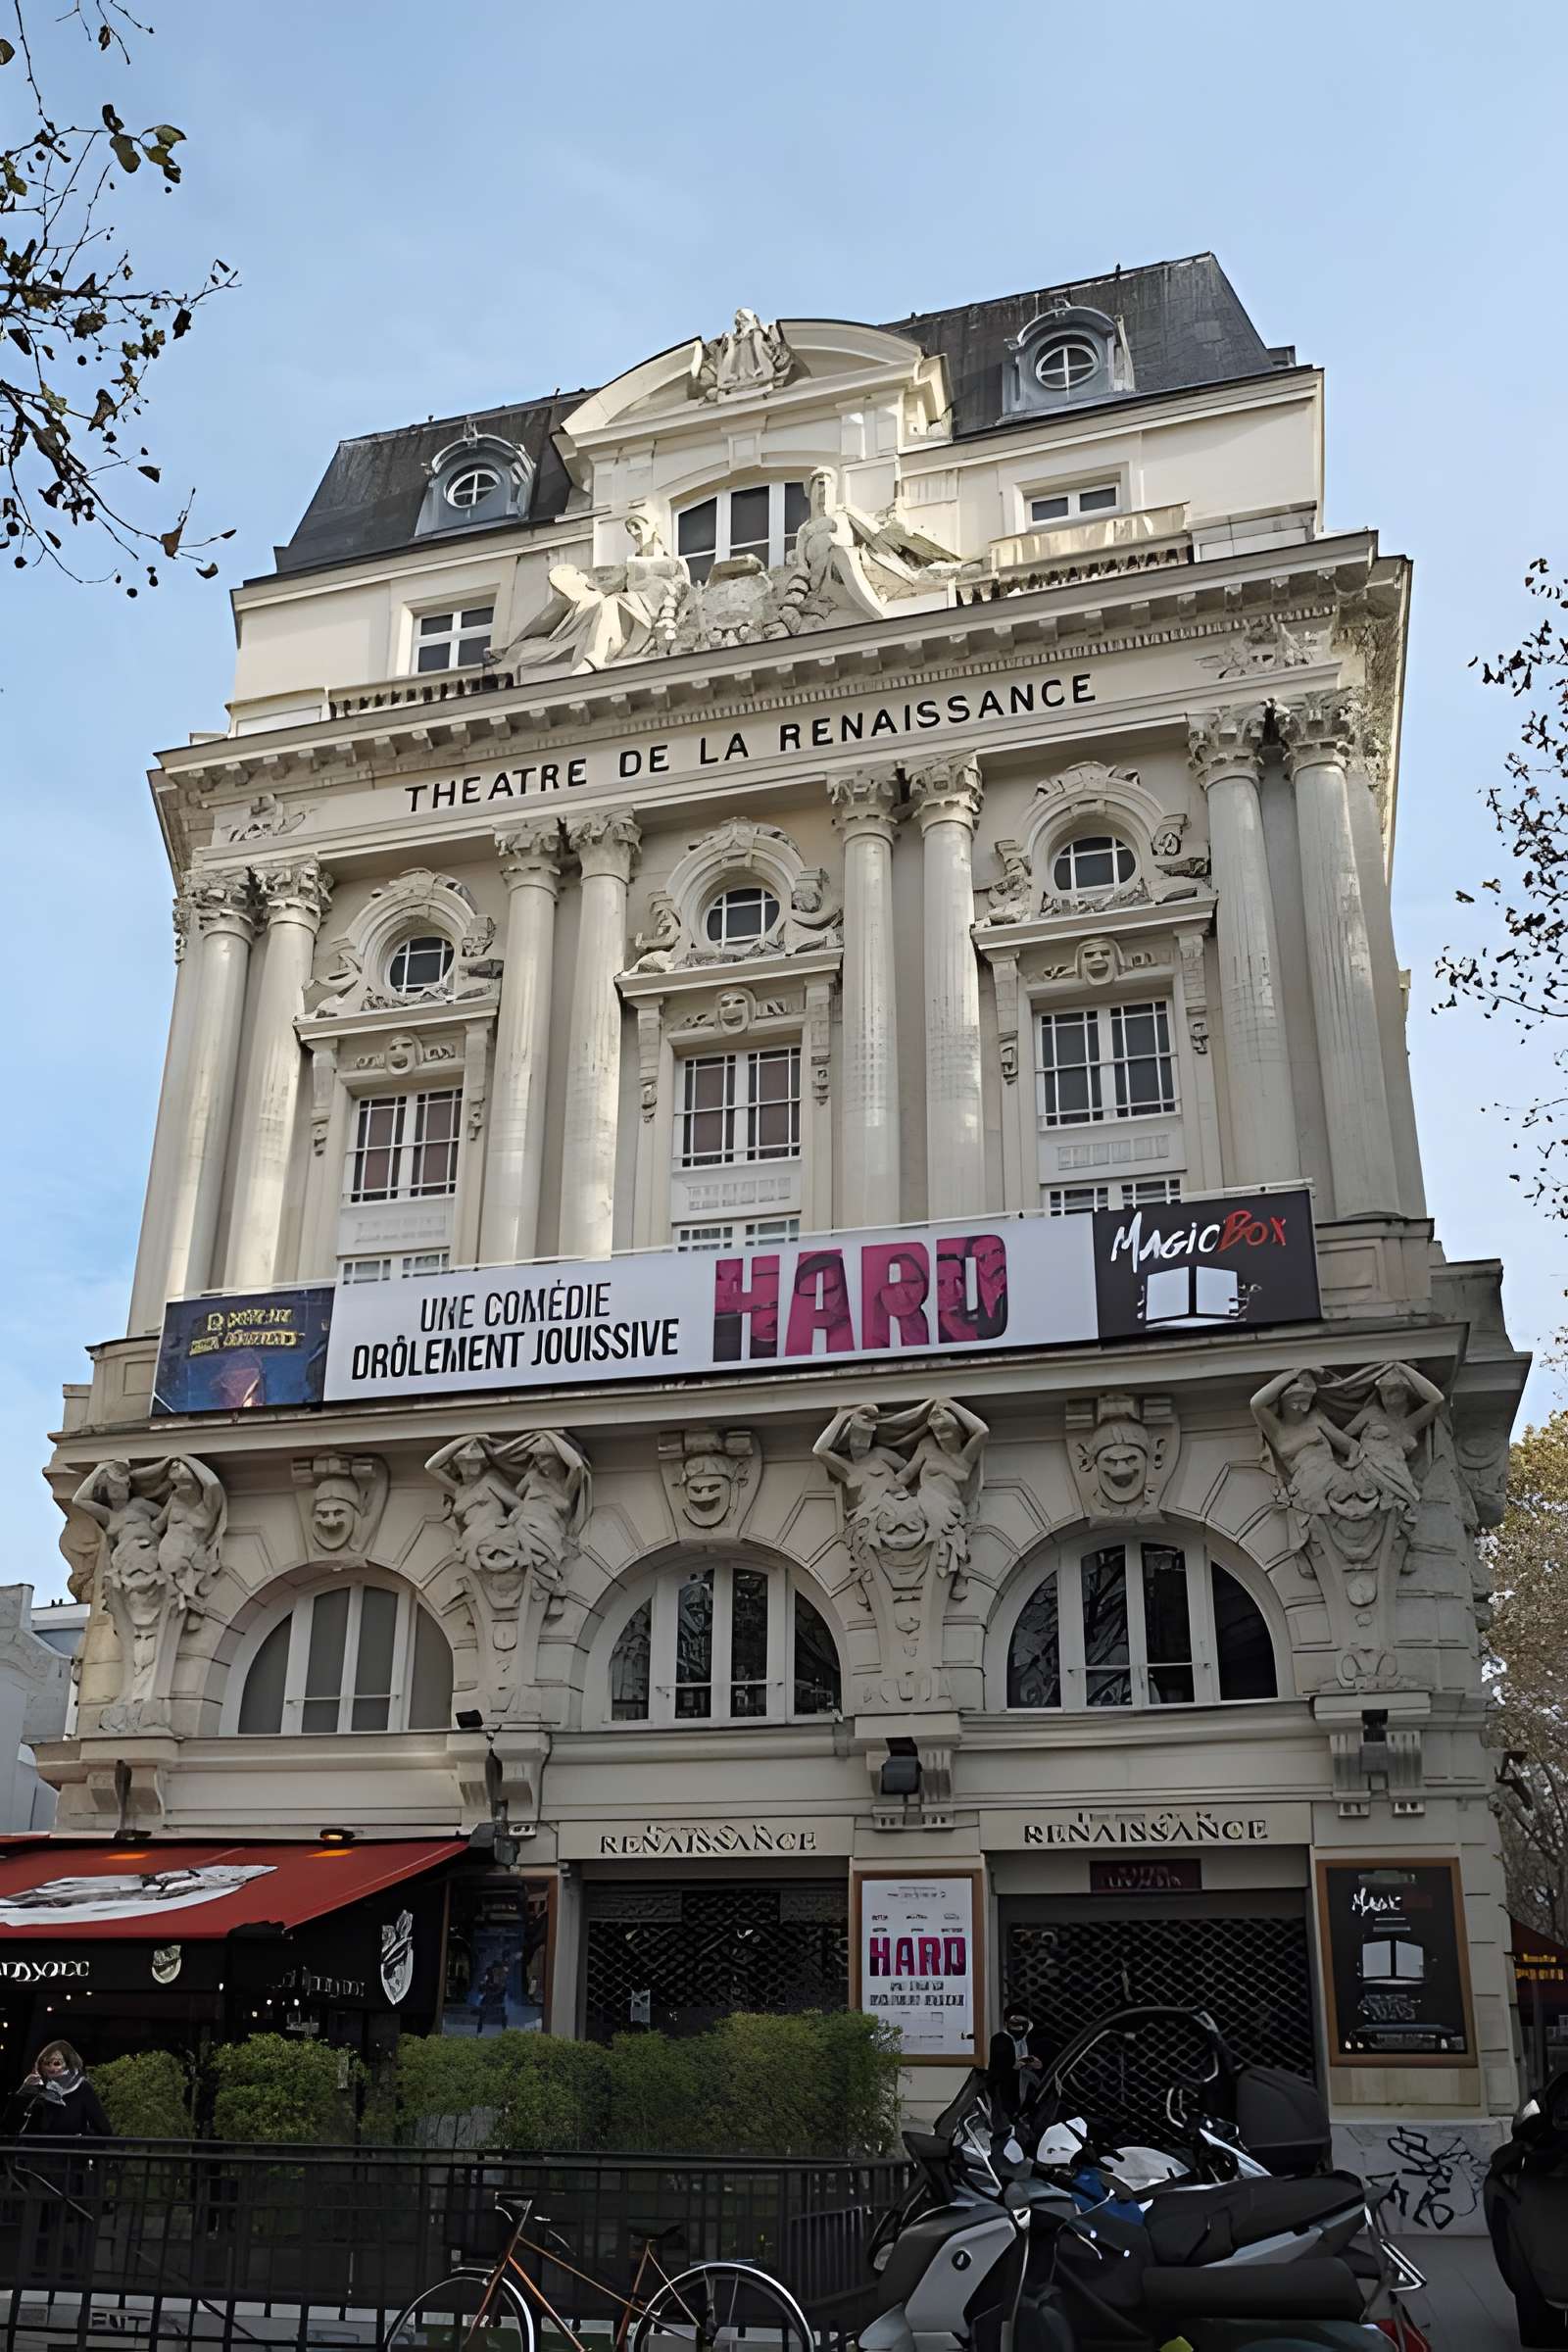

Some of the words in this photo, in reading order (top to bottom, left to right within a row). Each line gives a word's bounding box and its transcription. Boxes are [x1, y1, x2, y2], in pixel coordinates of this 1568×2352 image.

[406, 758, 588, 812] THEATRE
[619, 744, 669, 778] DE
[700, 732, 750, 765] LA
[780, 673, 1097, 751] RENAISSANCE
[420, 1293, 475, 1332] UNE
[489, 1279, 612, 1326] COMÉDIE
[712, 1234, 1008, 1363] HARD
[352, 1335, 526, 1380] DRÔLEMENT
[531, 1318, 680, 1366] JOUISSIVE
[600, 1824, 817, 1854] RENAISSANCE
[1024, 1811, 1269, 1843] RENAISSANCE
[869, 1936, 966, 1977] HARD
